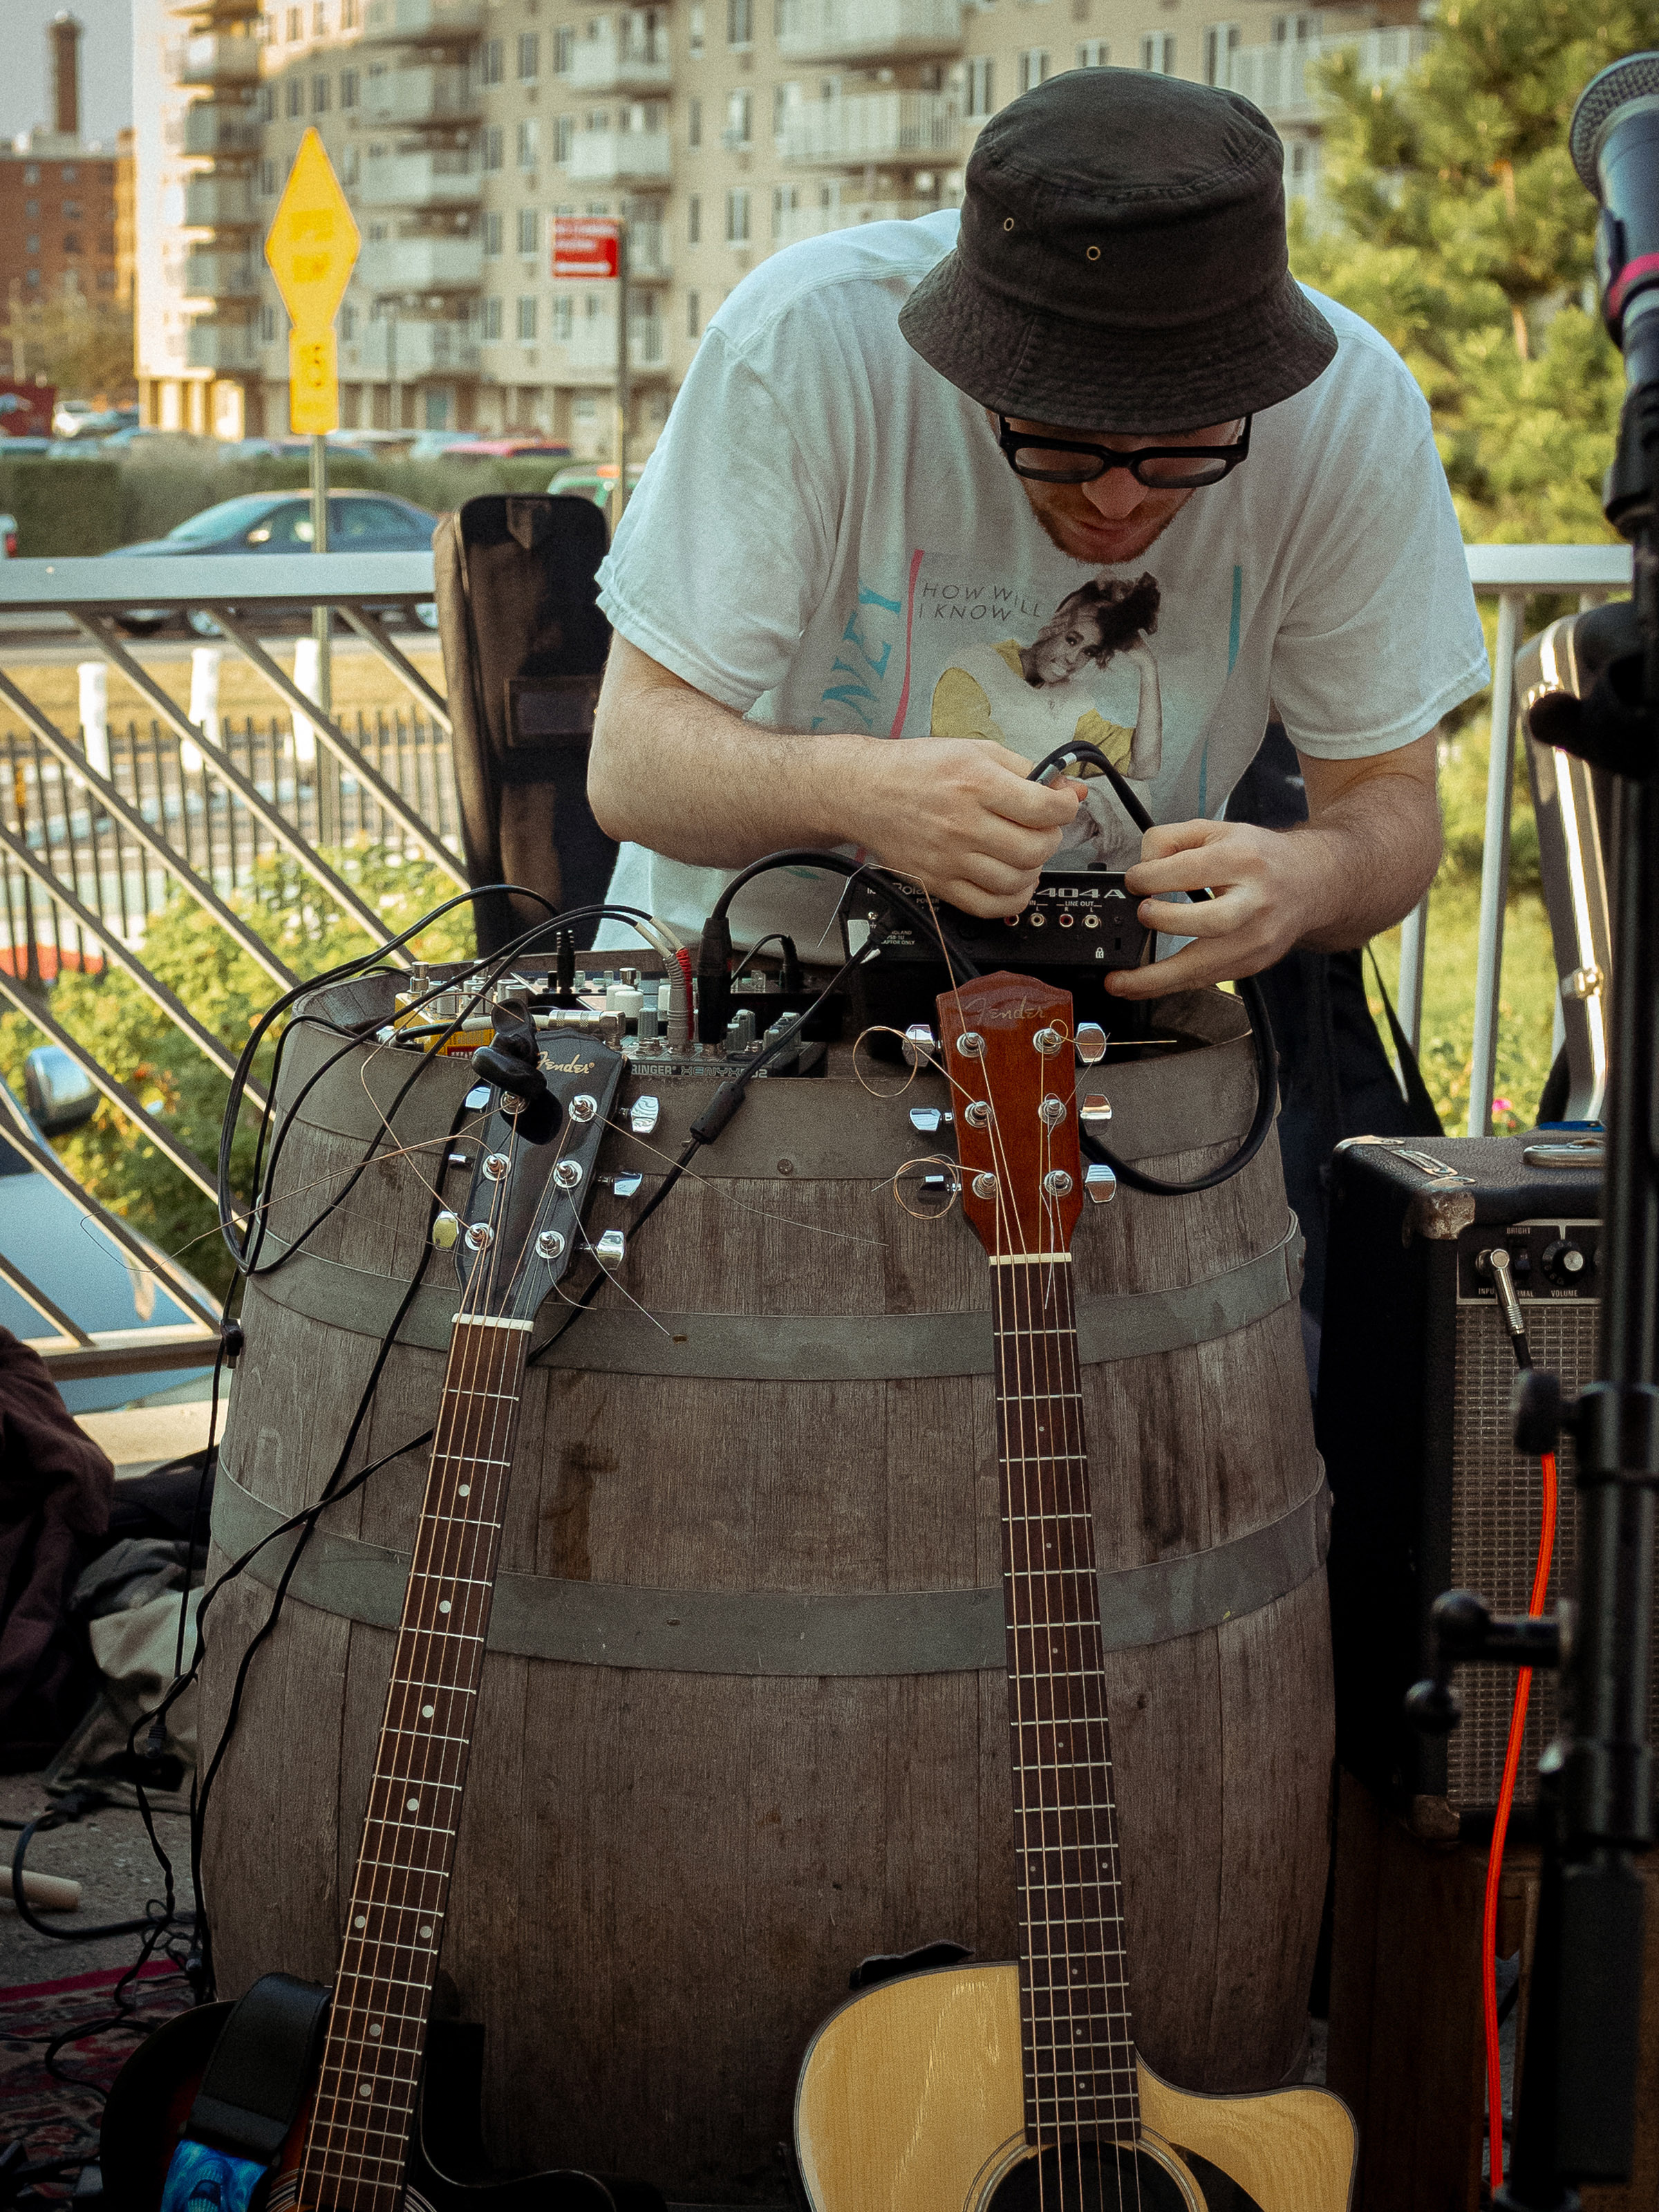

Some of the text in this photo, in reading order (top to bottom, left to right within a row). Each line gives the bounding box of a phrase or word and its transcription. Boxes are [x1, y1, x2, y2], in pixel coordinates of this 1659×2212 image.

[919, 603, 1012, 621] I KNOW
[923, 583, 1040, 618] HOW WILL
[965, 995, 1045, 1025] Fender
[1550, 1289, 1579, 1297] VOLUME
